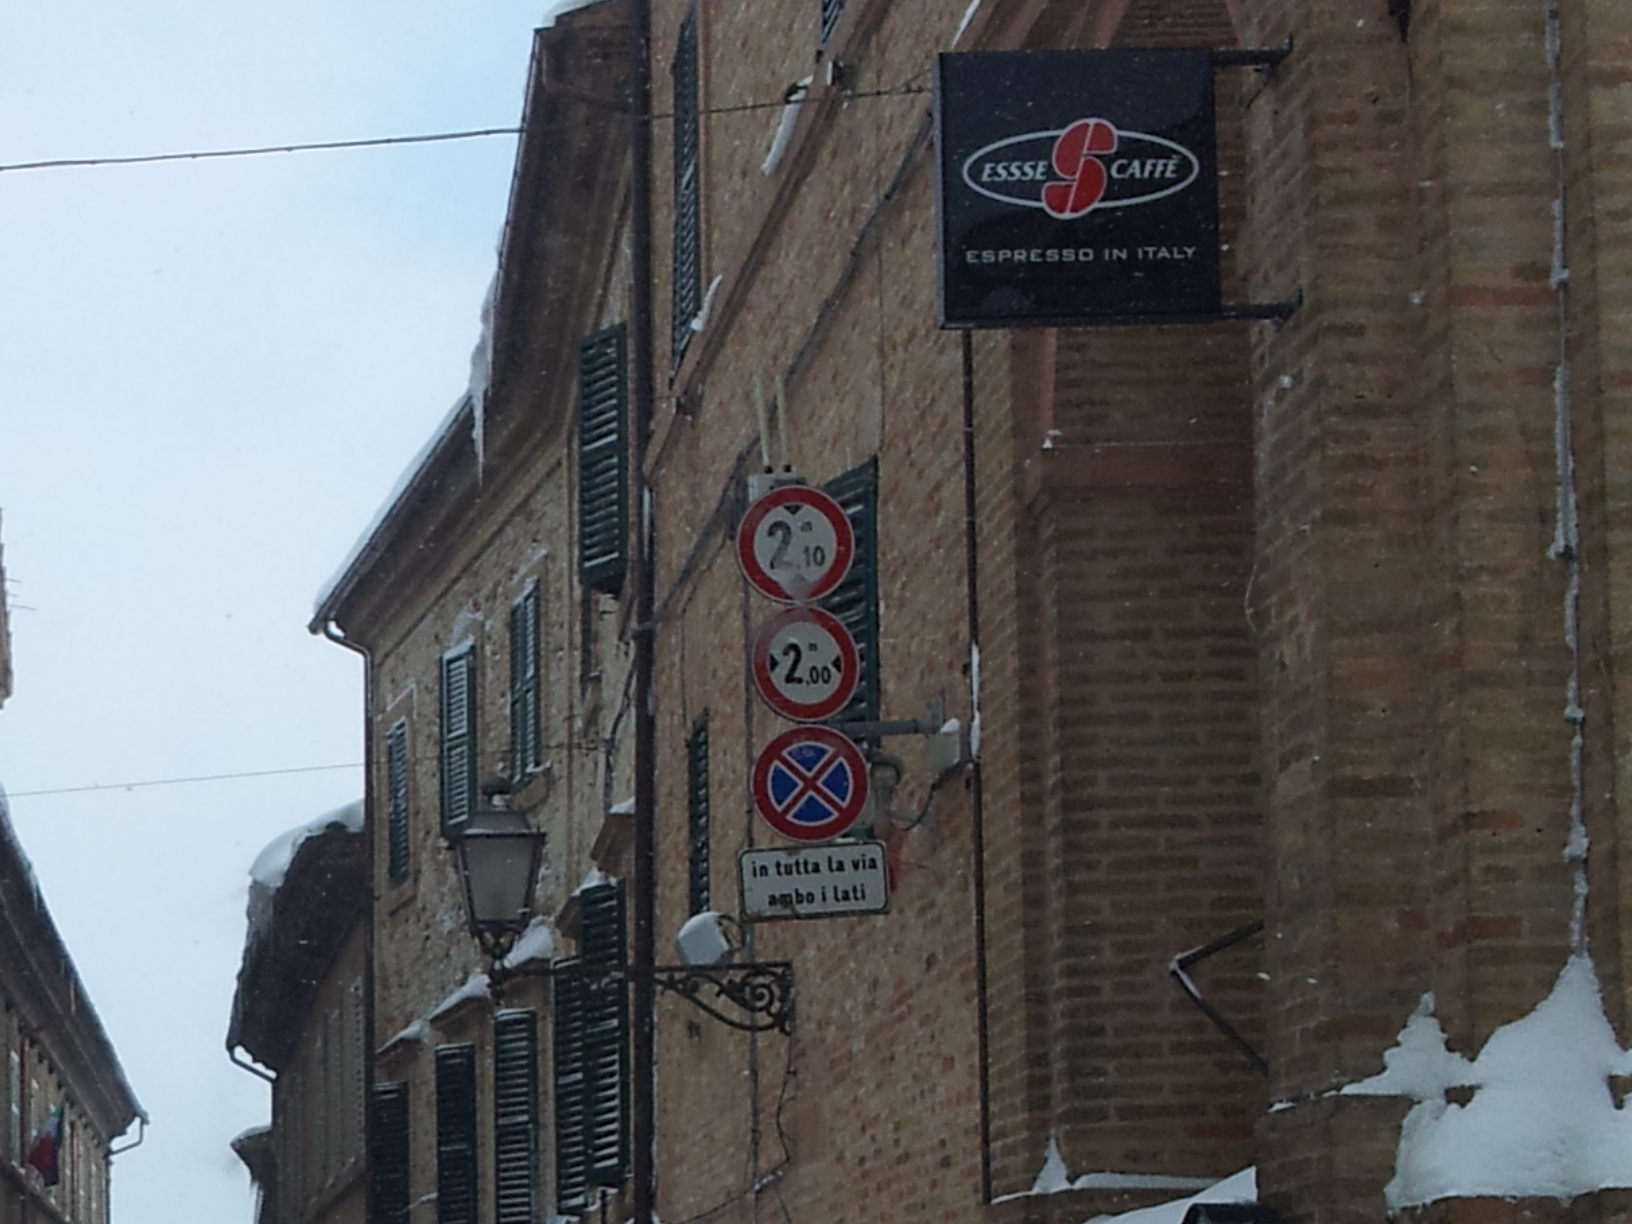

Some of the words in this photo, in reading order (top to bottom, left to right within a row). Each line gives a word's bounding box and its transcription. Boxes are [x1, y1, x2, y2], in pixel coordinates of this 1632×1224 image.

[981, 161, 1048, 182] ESSSE
[966, 248, 1094, 263] ESPRESSO
[1104, 249, 1128, 261] IN
[1138, 246, 1197, 260] ITALY
[751, 860, 769, 878] in
[775, 857, 821, 877] tutta
[827, 855, 846, 873] la
[852, 853, 878, 871] via
[768, 887, 816, 907] ambo
[821, 886, 827, 903] i
[833, 883, 866, 903] lati
